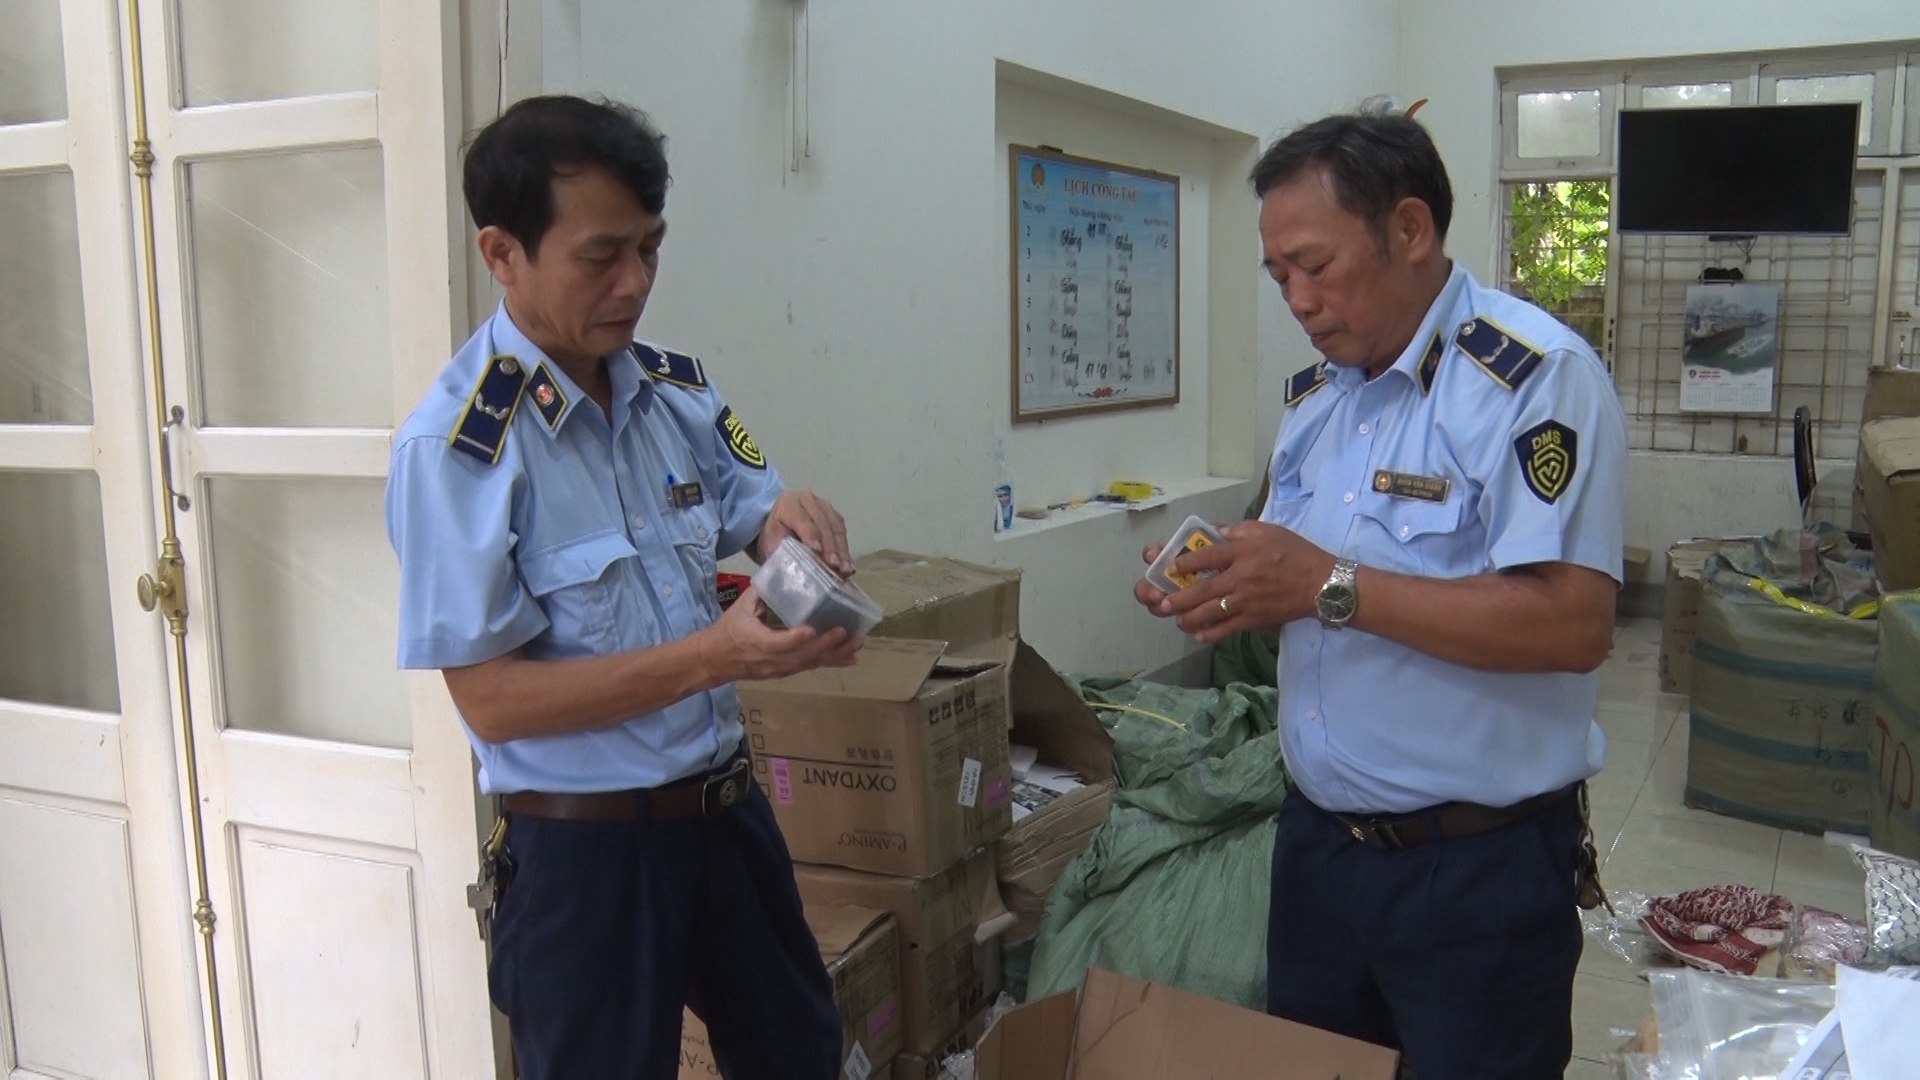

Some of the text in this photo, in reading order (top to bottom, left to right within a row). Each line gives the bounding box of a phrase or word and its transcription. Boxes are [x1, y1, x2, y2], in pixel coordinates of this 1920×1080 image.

[1064, 177, 1139, 203] LỊCH CÔNG TÁC
[1026, 226, 1031, 237] 2
[1026, 248, 1031, 260] 3
[1026, 273, 1031, 284] 4
[1026, 297, 1031, 309] 5
[1026, 322, 1031, 334] 6
[1026, 347, 1032, 358] 7
[1531, 429, 1562, 451] DMS
[803, 767, 897, 792] OXYDANT
